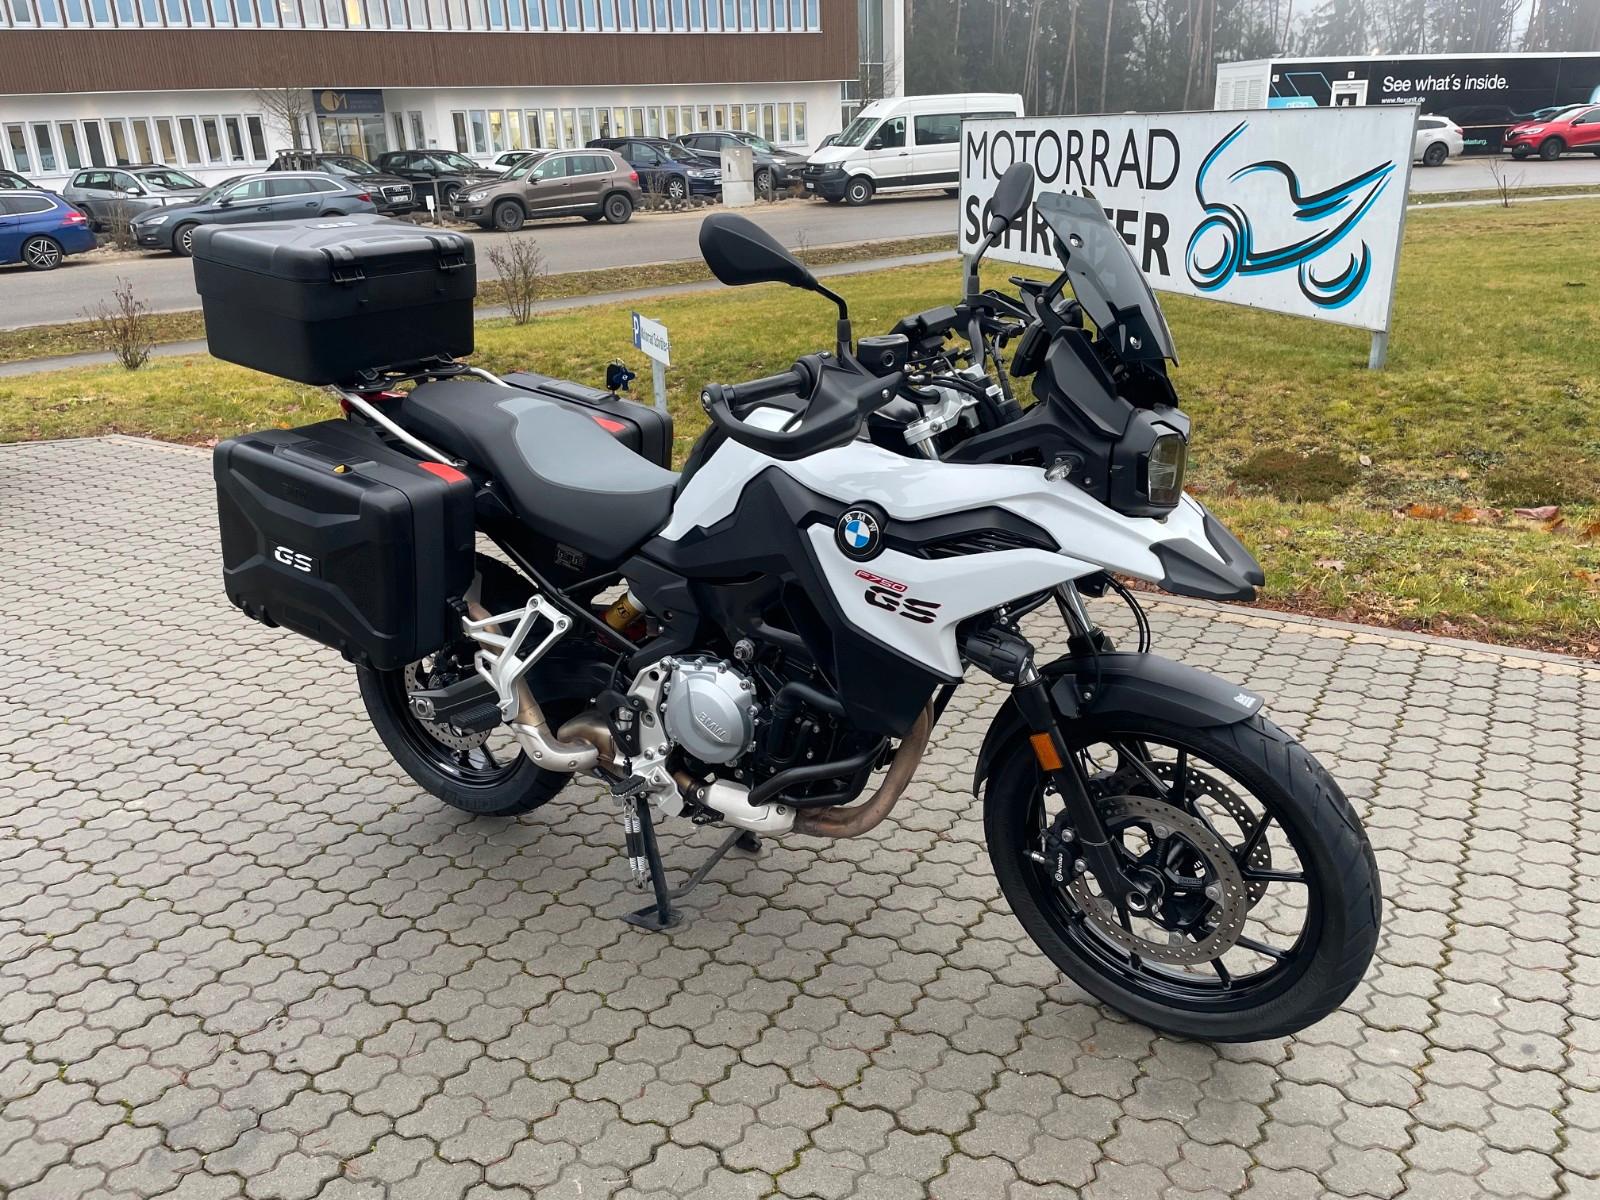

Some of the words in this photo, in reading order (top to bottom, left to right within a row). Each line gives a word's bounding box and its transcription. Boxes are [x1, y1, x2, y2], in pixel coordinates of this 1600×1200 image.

[1382, 75, 1412, 92] See
[1464, 73, 1509, 90] inside.
[966, 128, 1181, 190] MOTORRAD
[633, 315, 640, 345] P
[845, 512, 877, 533] BMW
[274, 545, 313, 572] GS
[864, 585, 942, 624] GS
[699, 711, 727, 737] BMW
